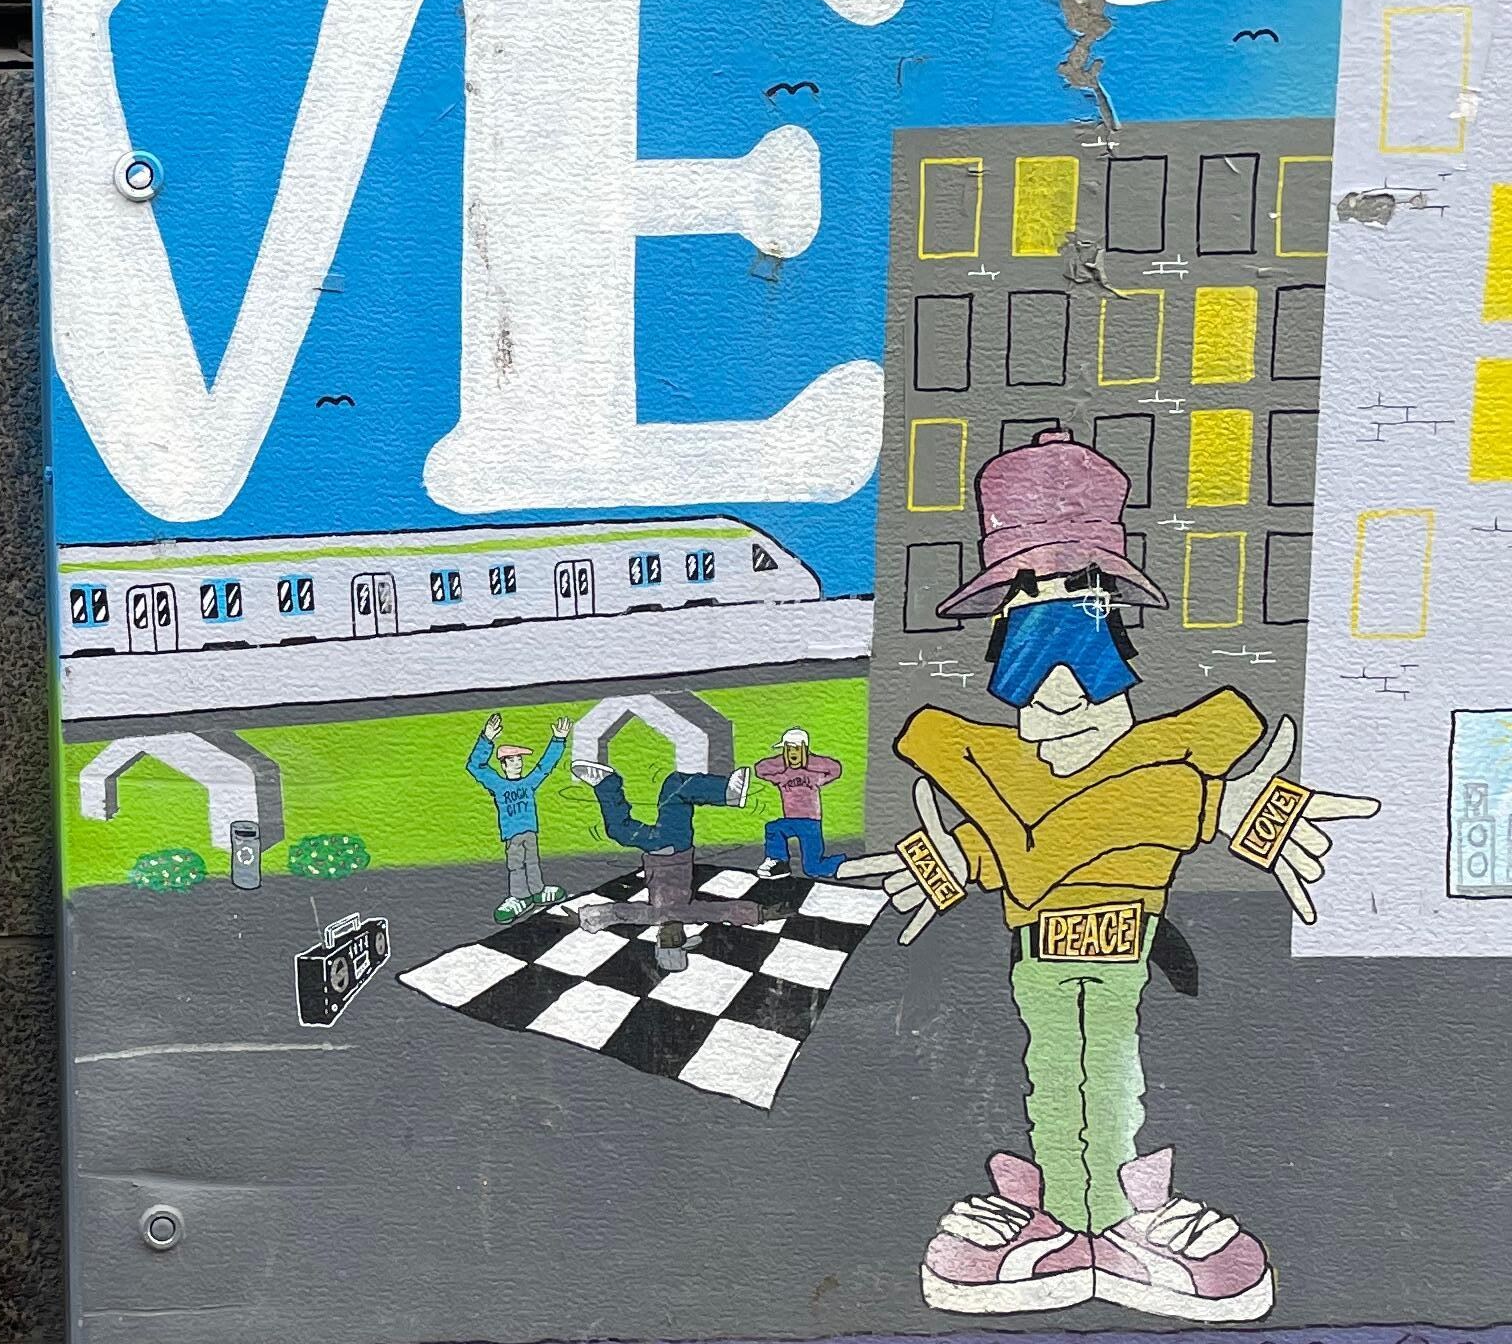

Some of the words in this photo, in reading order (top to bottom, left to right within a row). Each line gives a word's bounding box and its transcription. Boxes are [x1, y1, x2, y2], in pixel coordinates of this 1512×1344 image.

[502, 787, 528, 804] ROCK
[506, 801, 529, 817] CITY
[1243, 789, 1297, 854] LOVE
[906, 840, 958, 904] HATE
[1047, 908, 1135, 956] PEACE
